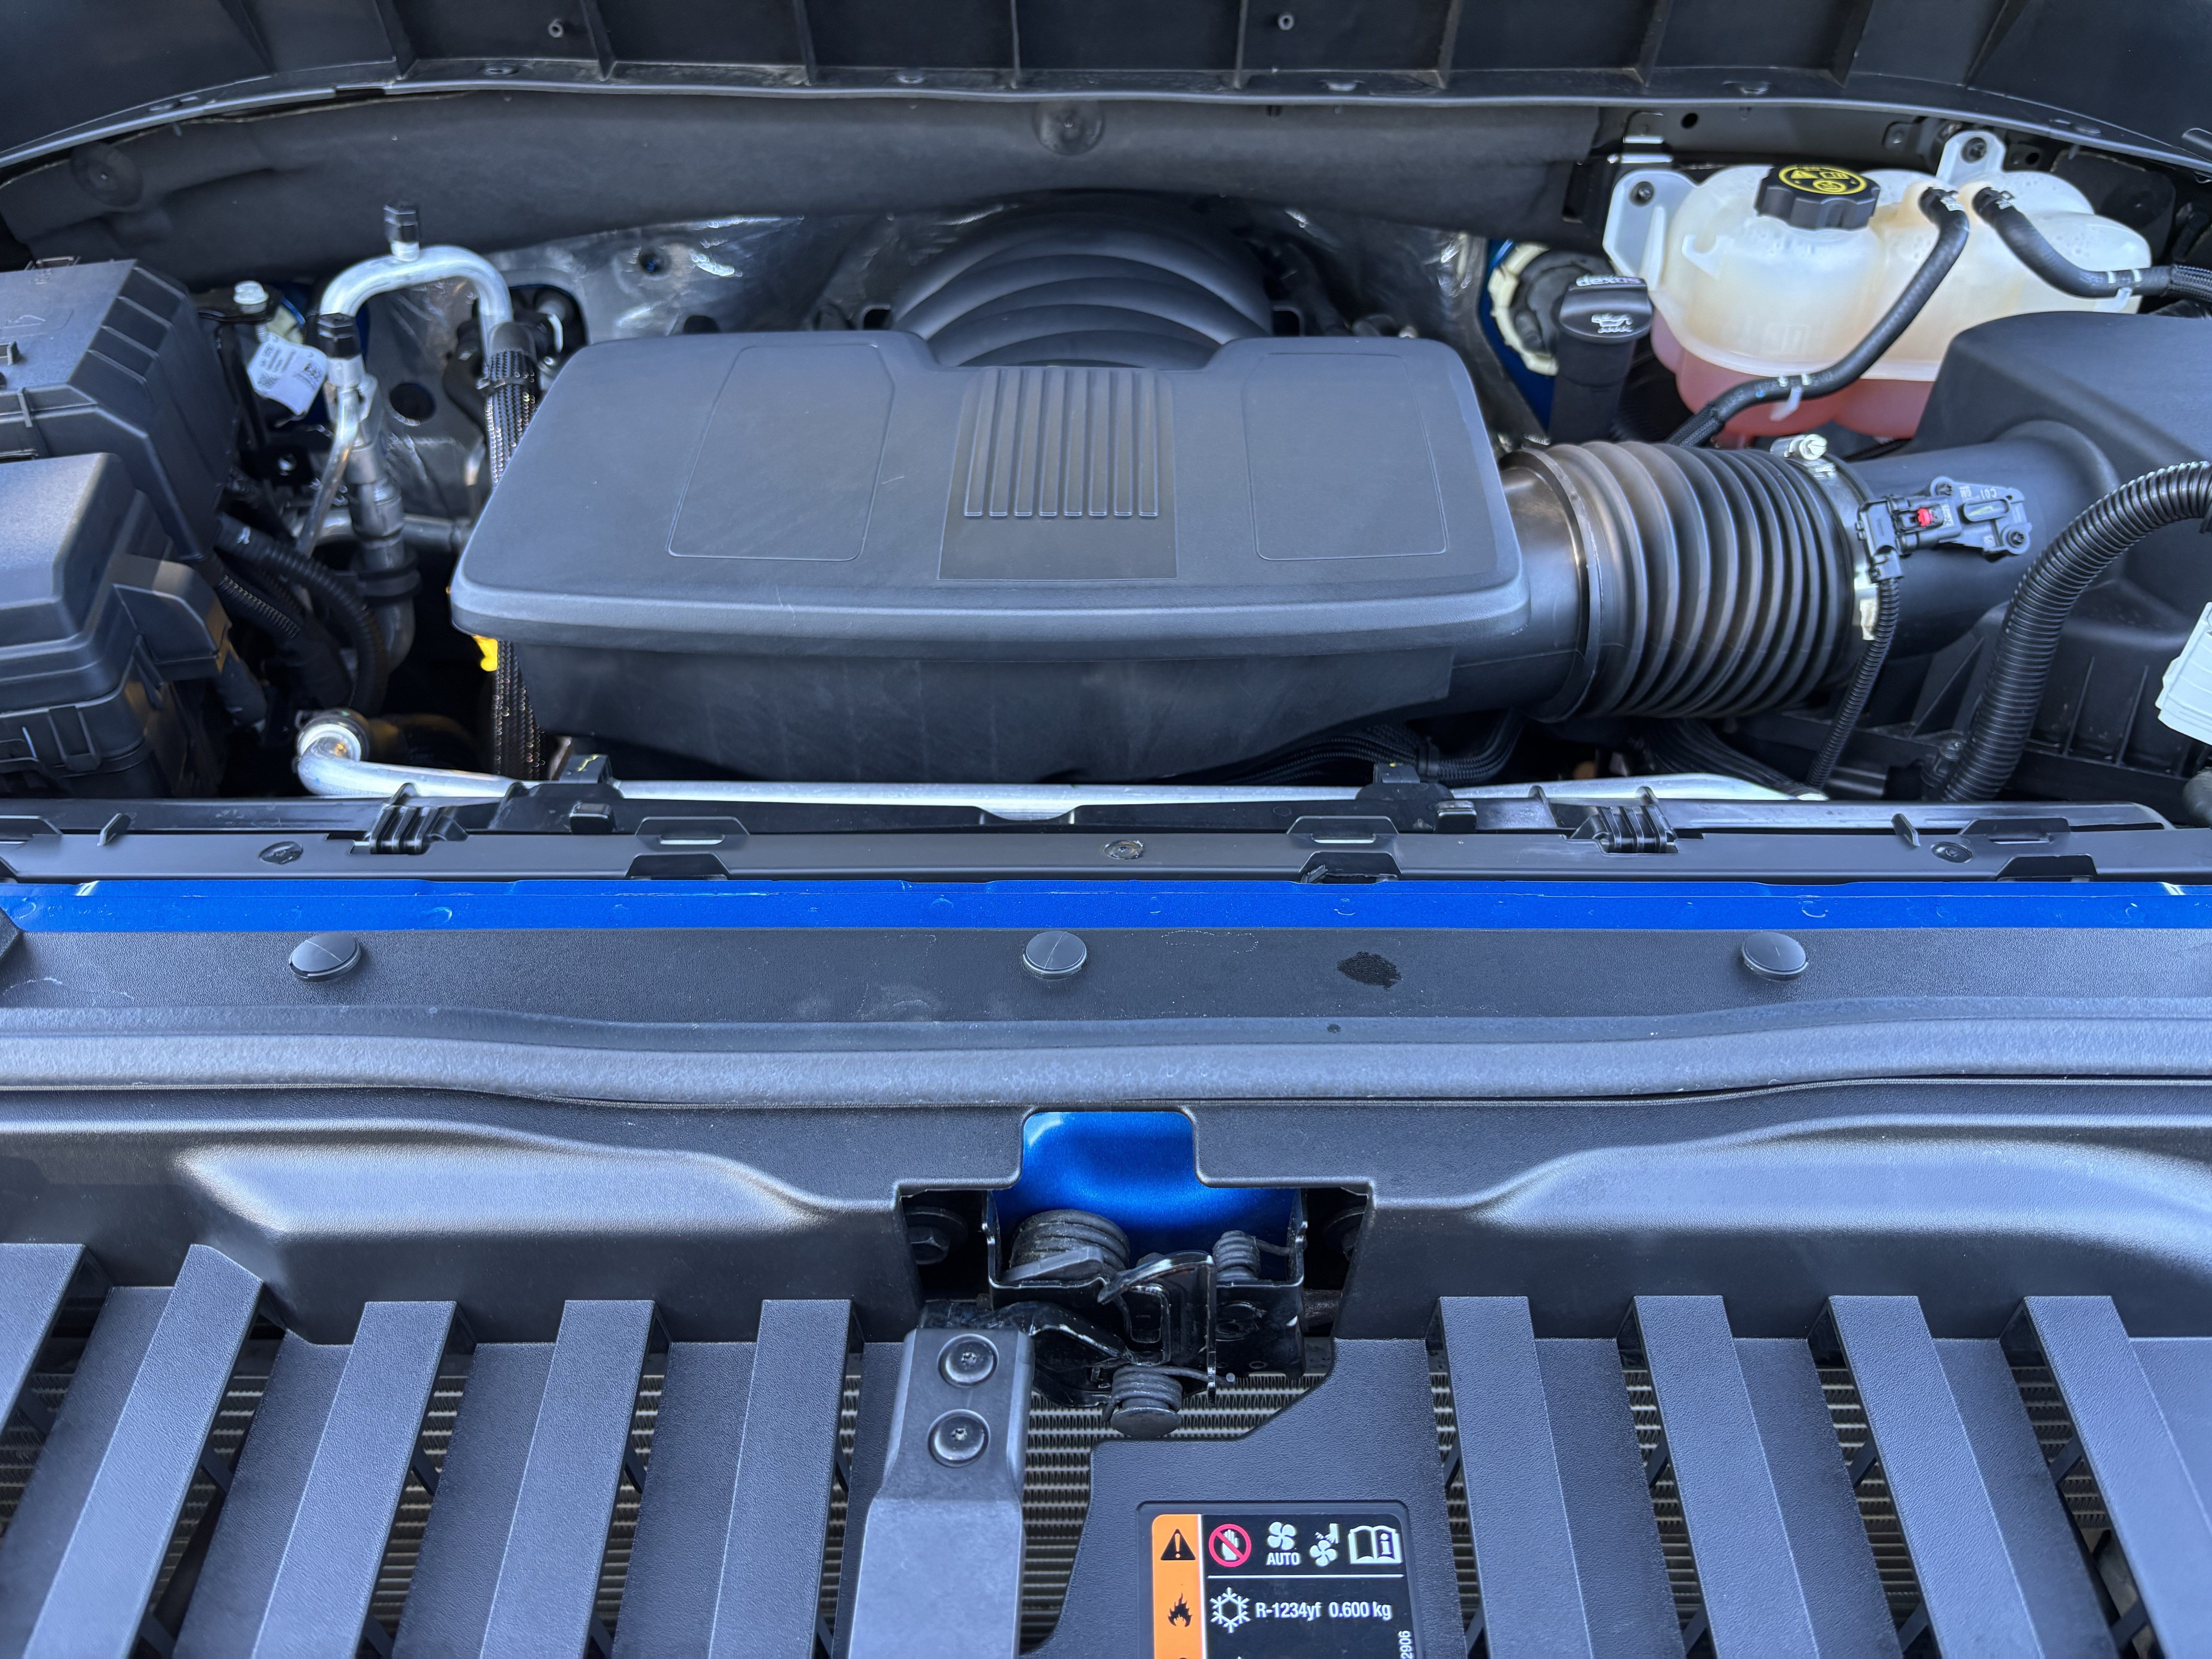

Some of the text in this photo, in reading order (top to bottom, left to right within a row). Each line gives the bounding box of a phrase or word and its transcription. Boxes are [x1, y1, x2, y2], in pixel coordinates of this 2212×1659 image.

[1576, 275, 1642, 287] dexos
[1266, 1552, 1301, 1566] AUTO
[1255, 1601, 1393, 1622] R-1234yf 0.600 kg
[1398, 1630, 1413, 1659] 2906
